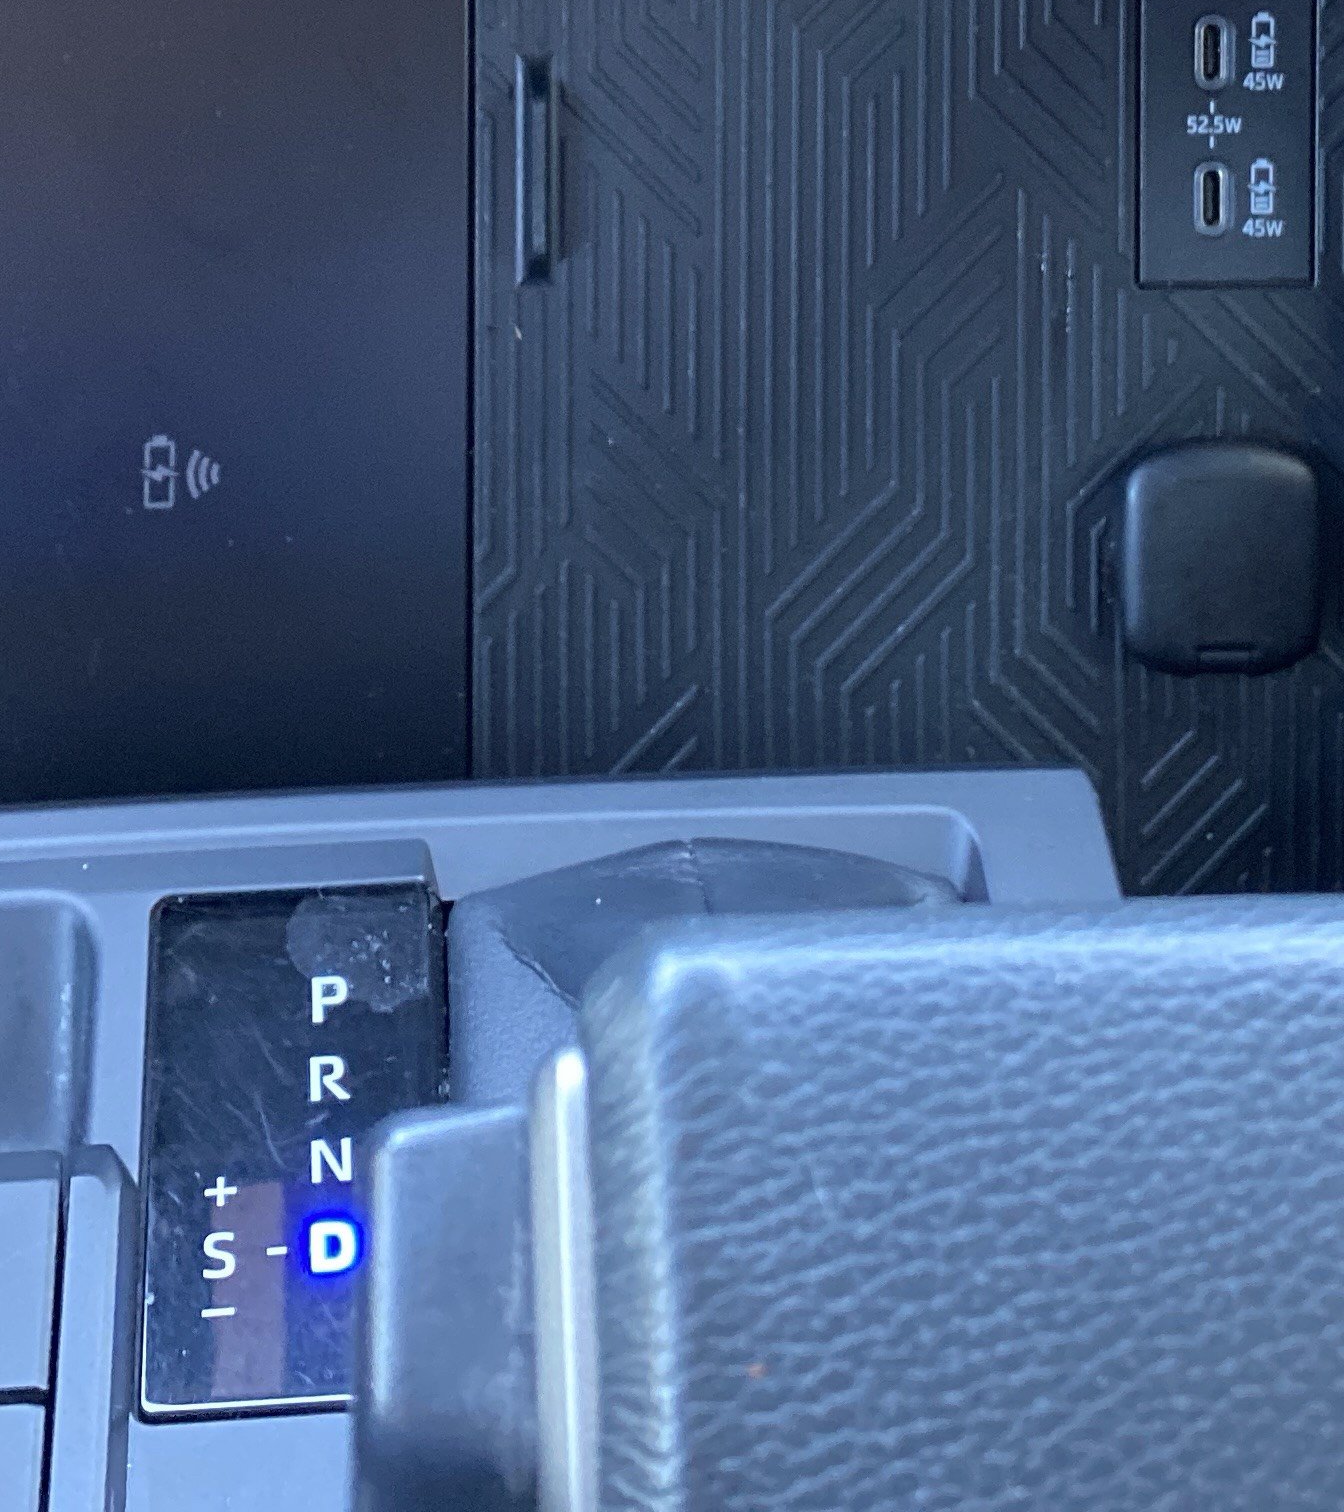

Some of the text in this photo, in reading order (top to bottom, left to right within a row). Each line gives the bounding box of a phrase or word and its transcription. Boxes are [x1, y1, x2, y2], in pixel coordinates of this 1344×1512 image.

[1242, 72, 1285, 91] 45W
[1186, 114, 1242, 135] 52.5W
[1241, 218, 1284, 238] 45W
[311, 975, 348, 1024] P
[309, 1055, 351, 1102] R
[310, 1137, 353, 1184] N
[202, 1231, 237, 1280] S
[309, 1219, 358, 1274] D
